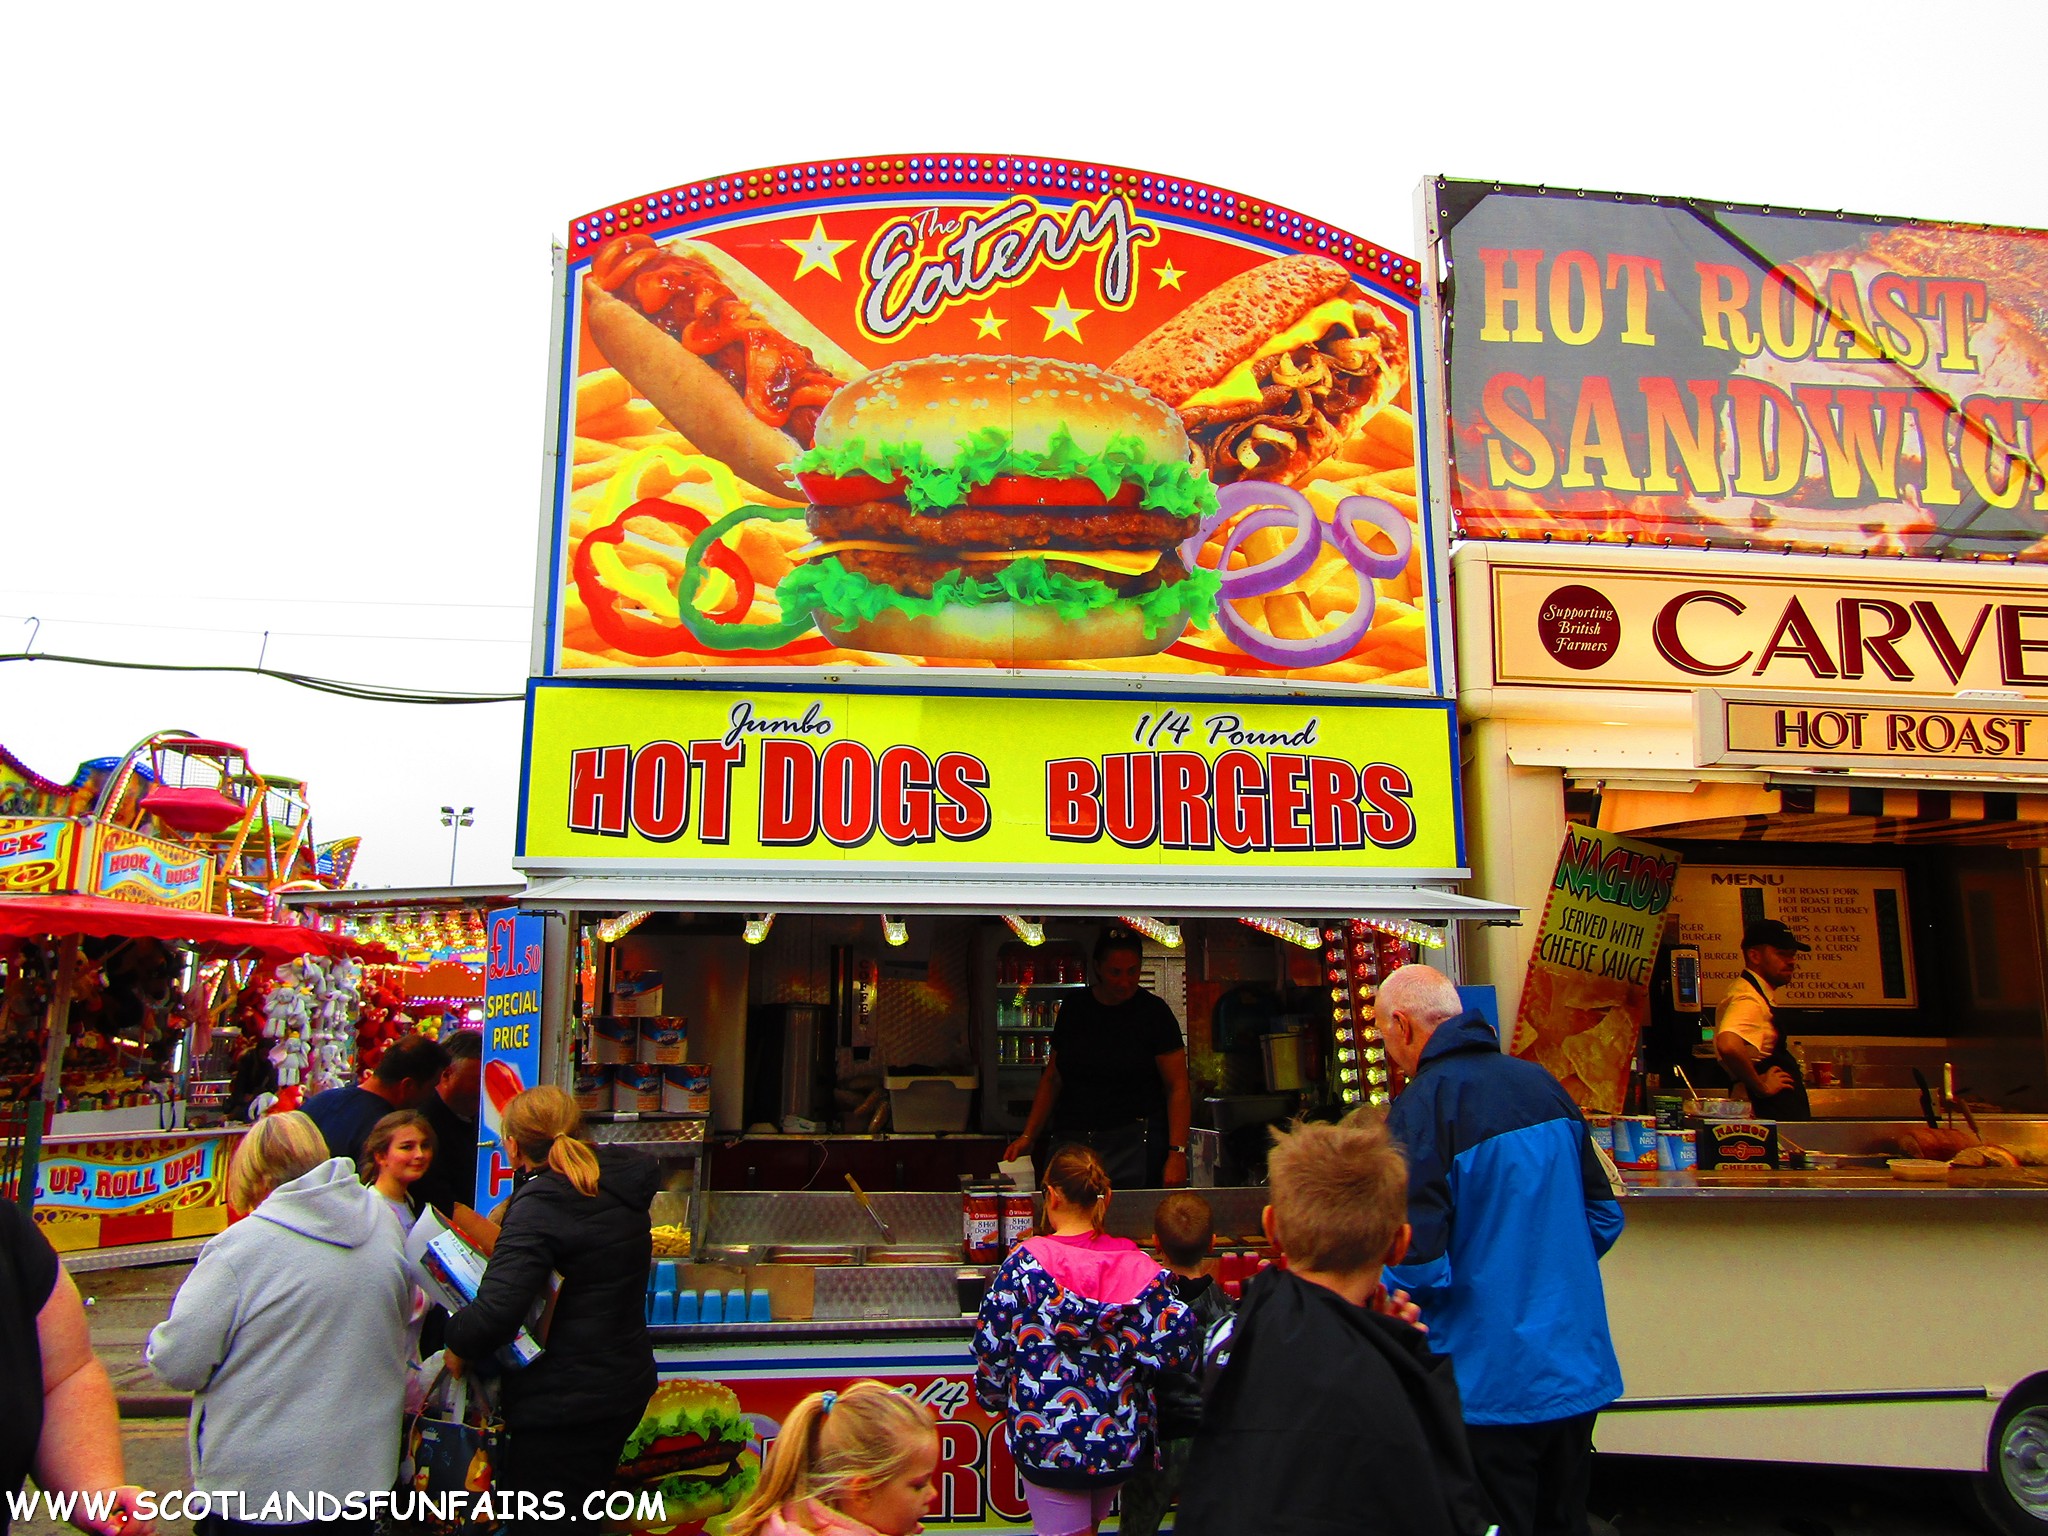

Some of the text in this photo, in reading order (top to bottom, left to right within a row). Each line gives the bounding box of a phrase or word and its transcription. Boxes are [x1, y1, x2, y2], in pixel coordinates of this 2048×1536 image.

[910, 207, 962, 241] The
[860, 193, 1156, 340] Eatery
[1478, 247, 1988, 374] HOT ROAST
[1543, 604, 1614, 622] Supporting
[1558, 619, 1603, 635] British
[1553, 636, 1610, 654] Farmers
[1652, 589, 2048, 686] CARVE
[722, 701, 834, 748] Jumbo
[1134, 709, 1320, 749] 1/4 Pound
[1774, 708, 2033, 757] HOT ROAST
[568, 738, 991, 848] HOT DOGS
[1045, 749, 1417, 853] BURGERS
[108, 853, 200, 886] HOOK A DUCK
[1711, 873, 1785, 886] MENU
[1777, 887, 1796, 895] HOT
[1779, 906, 1798, 914] HOT
[1801, 906, 1831, 914] ROAST
[1801, 897, 1830, 905] ROAST
[1834, 897, 1856, 905] BEEF
[1559, 906, 1645, 950] SERVED WITH
[1679, 923, 1704, 931] RGER
[1780, 915, 1809, 923] CHIPS
[1682, 933, 1722, 941] BURGER
[1788, 925, 1856, 933] HIPS & GRAVY
[488, 915, 541, 981] £1.50
[1825, 935, 1862, 943] CHEESE
[1826, 944, 1858, 952] CURRY
[1539, 933, 1649, 986] CHEESE SAUCE
[1704, 952, 1738, 960] BURGER
[1817, 953, 1842, 961] FRIES
[1792, 972, 1822, 980] OFFEE
[487, 989, 539, 1018] SPECIAL
[1786, 991, 1854, 999] COLD DRINKS
[492, 1023, 531, 1050] PRICE
[1716, 1124, 1767, 1138] NACHOS
[95, 1168, 160, 1199] ROLL
[164, 1148, 205, 1187] UP!
